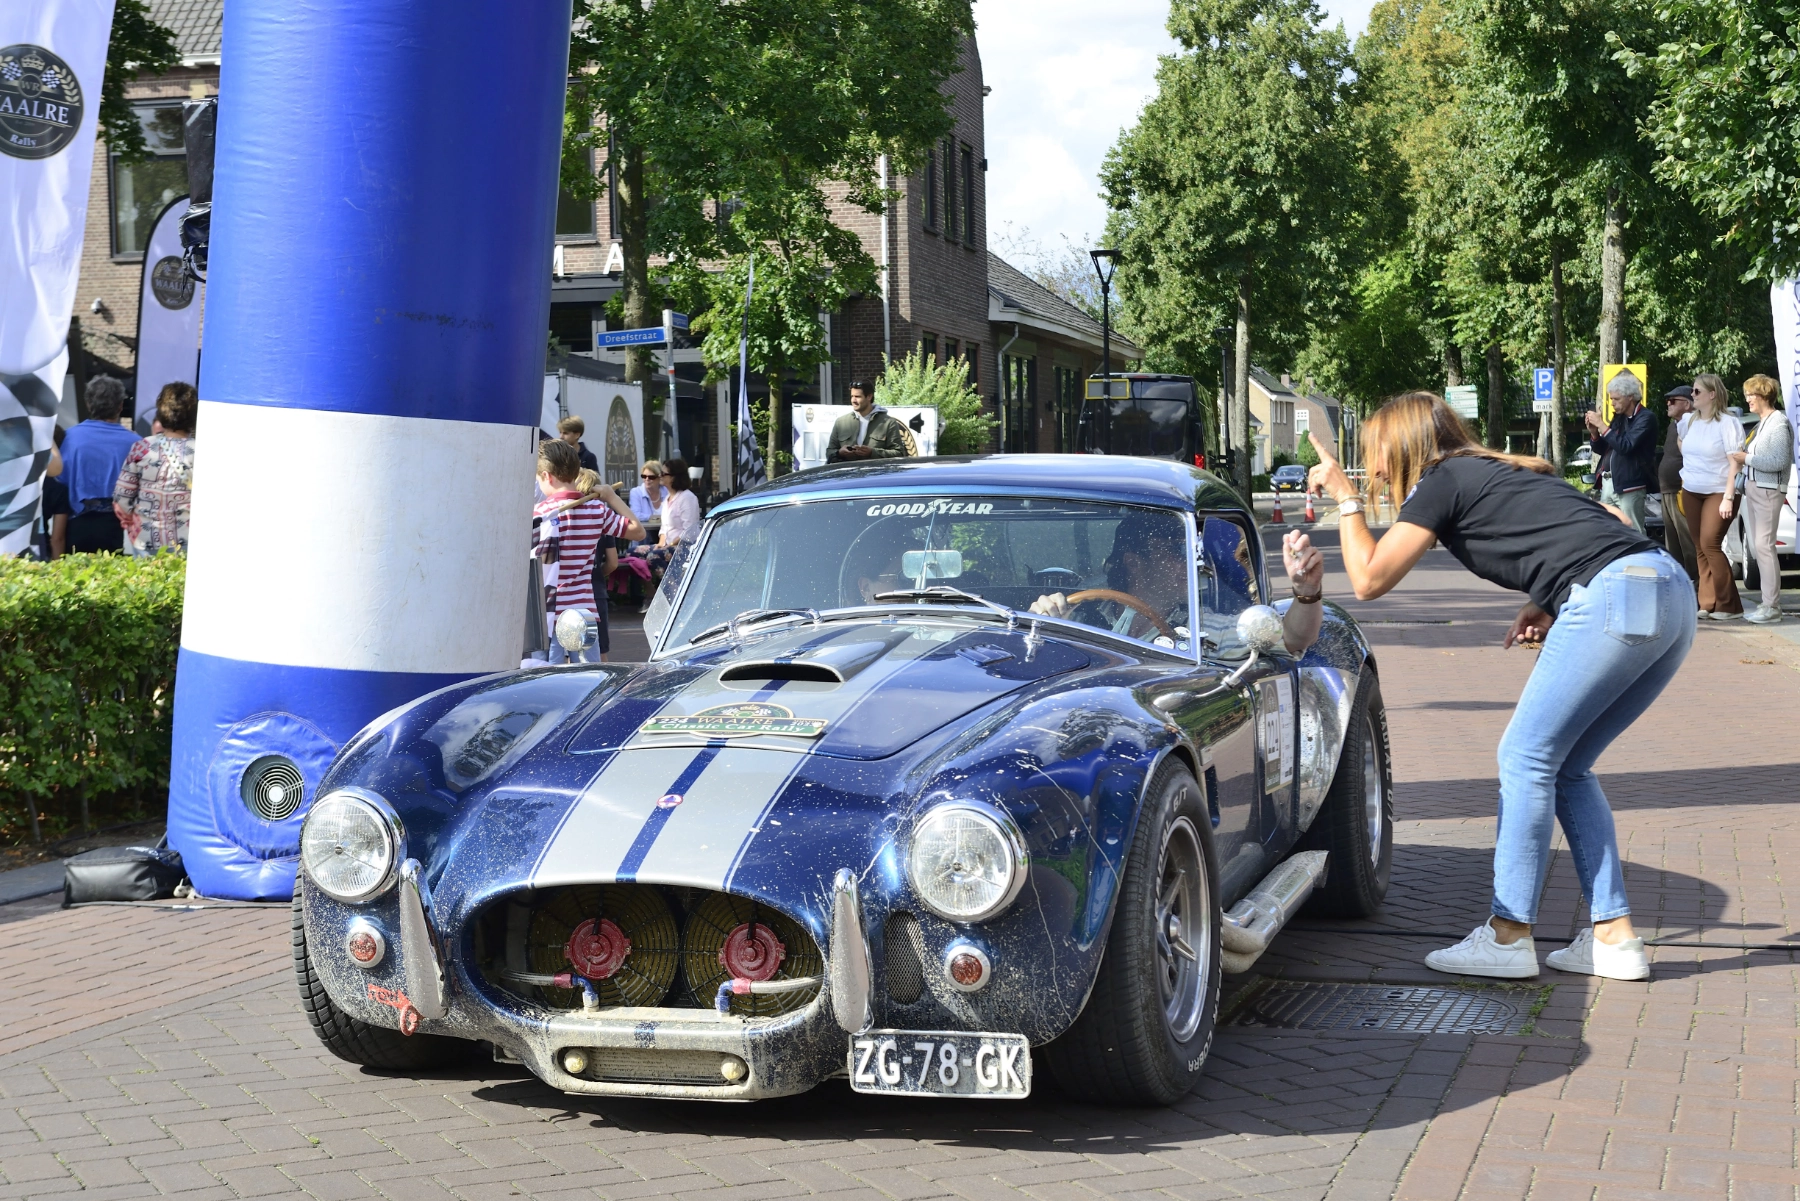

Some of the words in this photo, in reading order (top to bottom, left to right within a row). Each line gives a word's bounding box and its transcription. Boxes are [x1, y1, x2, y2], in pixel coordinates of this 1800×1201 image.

[21, 81, 40, 92] WR
[0, 95, 69, 124] AALRE
[605, 332, 657, 343] Dreefstraat
[697, 717, 776, 725] WAALRE
[855, 1040, 1024, 1089] ZG-78-GK
